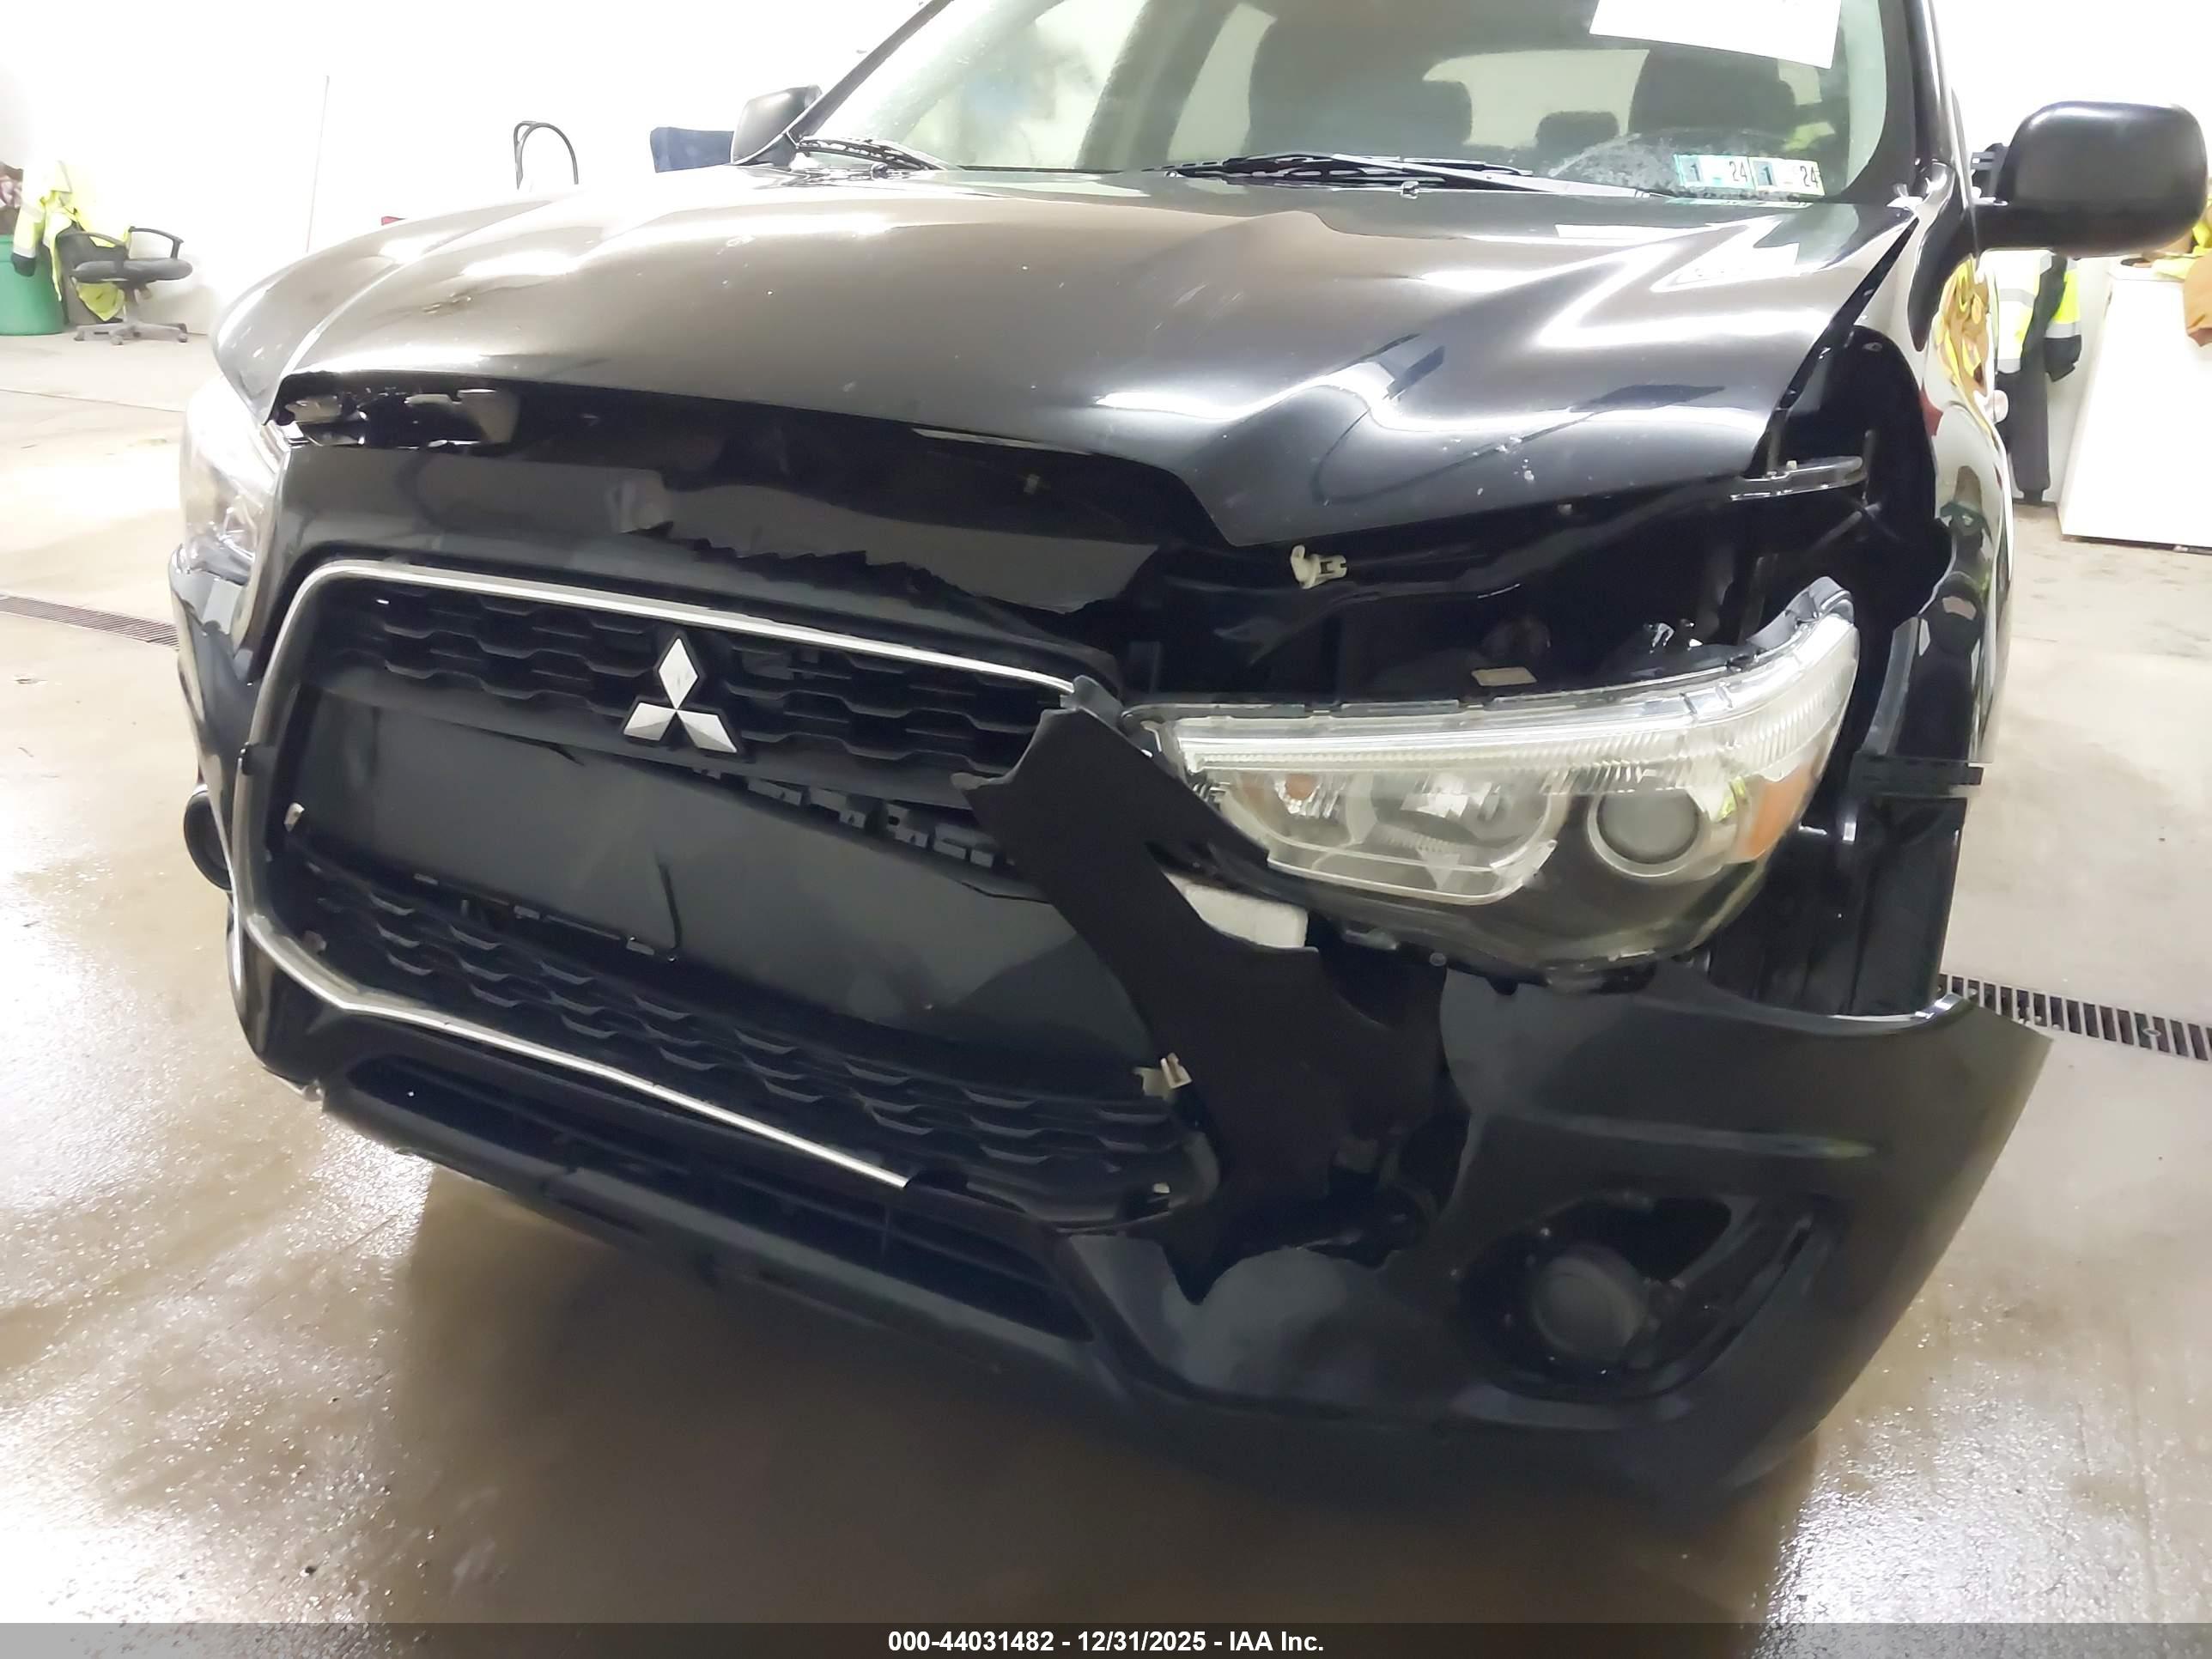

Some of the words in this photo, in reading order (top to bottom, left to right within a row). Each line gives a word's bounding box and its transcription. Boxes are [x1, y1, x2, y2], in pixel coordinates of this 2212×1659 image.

[1689, 162, 1701, 182] 1
[1729, 161, 1748, 182] 24
[1762, 166, 1774, 186] 1
[1799, 165, 1820, 188] 24
